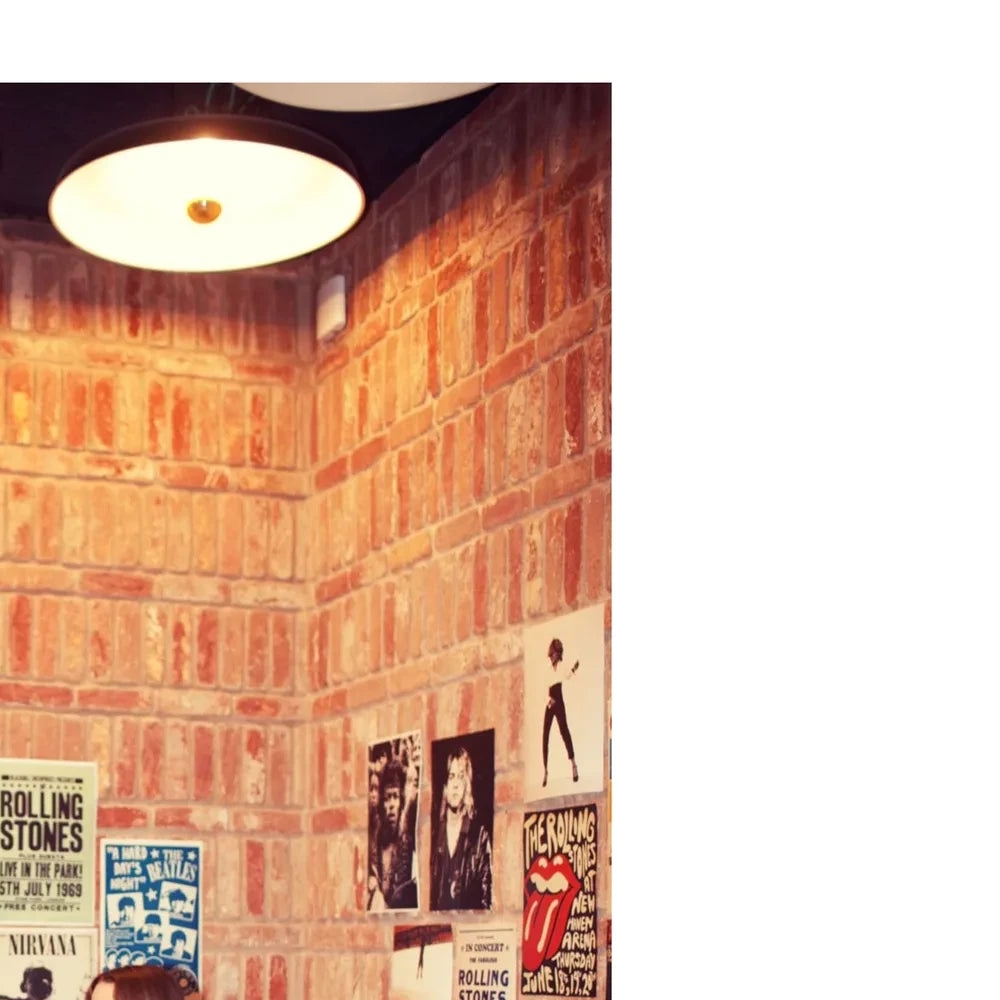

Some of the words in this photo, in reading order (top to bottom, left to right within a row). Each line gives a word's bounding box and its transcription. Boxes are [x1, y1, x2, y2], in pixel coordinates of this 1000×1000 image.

[0, 790, 83, 820] ROLLING
[0, 820, 83, 853] STONES
[524, 813, 547, 869] THE
[547, 808, 595, 858] ROLLING
[163, 849, 183, 861] THE
[0, 861, 17, 877] LIVE
[21, 862, 31, 877] IN
[35, 862, 50, 878] THE
[54, 863, 83, 878] PARK!
[147, 861, 197, 882] BEATLES
[0, 881, 20, 896] 5TH
[24, 882, 51, 897] JULY
[57, 883, 82, 897] 1969
[584, 870, 595, 892] AT
[4, 903, 26, 911] FREE
[572, 892, 595, 917] NEW
[9, 934, 76, 956] NIRVANA
[466, 944, 473, 952] IN
[474, 943, 504, 952] CONCERT
[562, 932, 595, 951] ARENA
[551, 951, 595, 973] THURSDAY
[459, 970, 509, 987] ROLLING
[523, 966, 553, 993] JUNE
